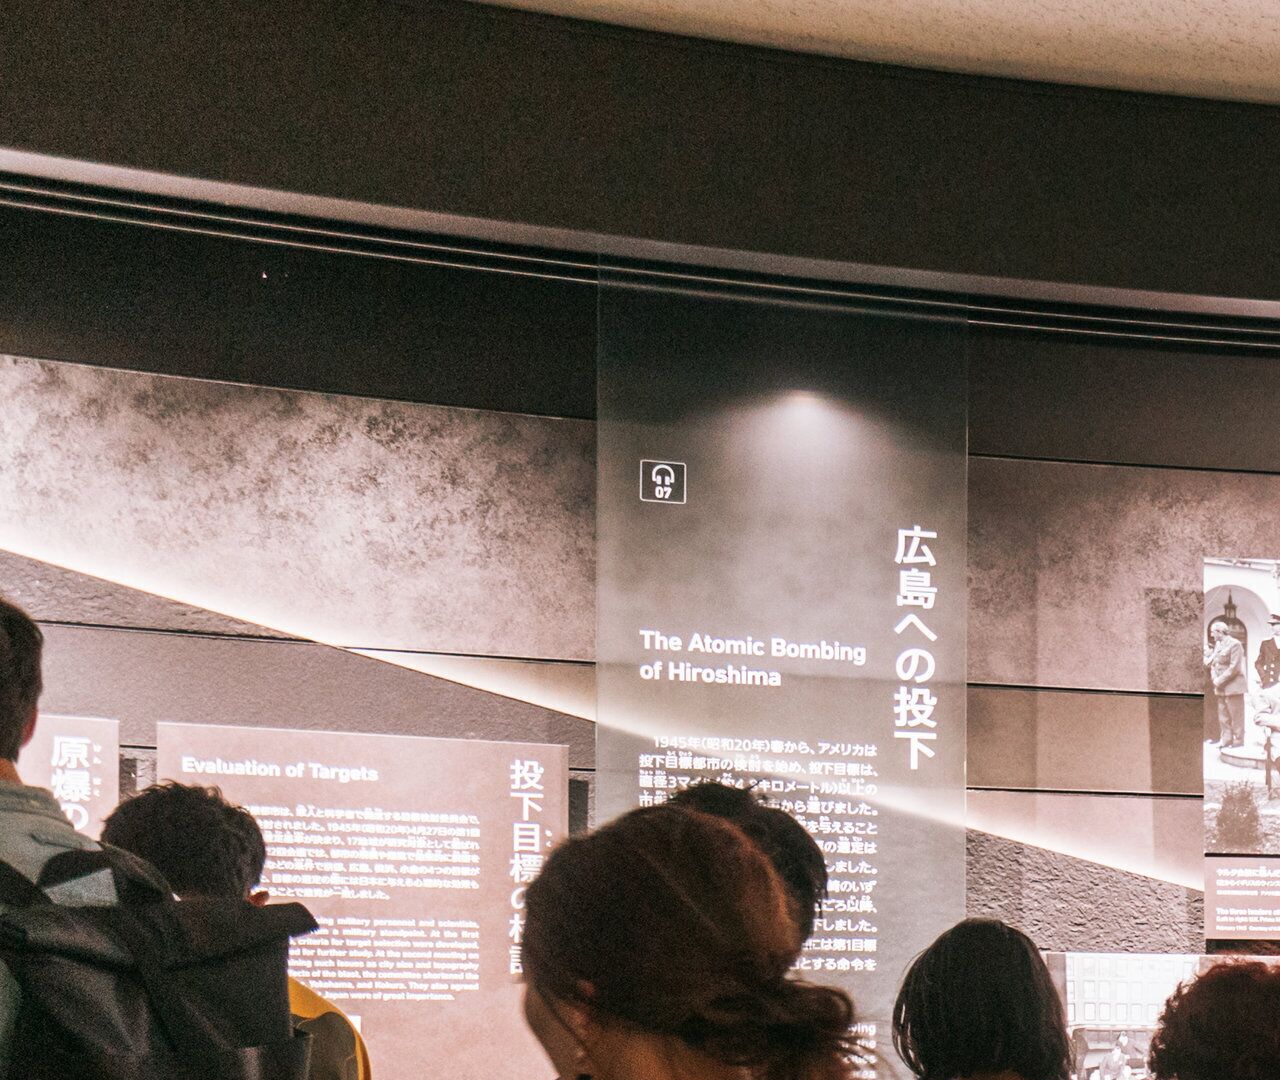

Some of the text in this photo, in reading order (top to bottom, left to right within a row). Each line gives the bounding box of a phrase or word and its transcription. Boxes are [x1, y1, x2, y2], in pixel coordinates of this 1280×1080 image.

[655, 486, 672, 499] 07
[639, 630, 866, 665] The Atomic Bombing
[894, 526, 937, 769] 広島への投下
[639, 661, 781, 686] of Hiroshima
[51, 735, 91, 831] 原爆の
[181, 757, 378, 782] Evaluation of Targets
